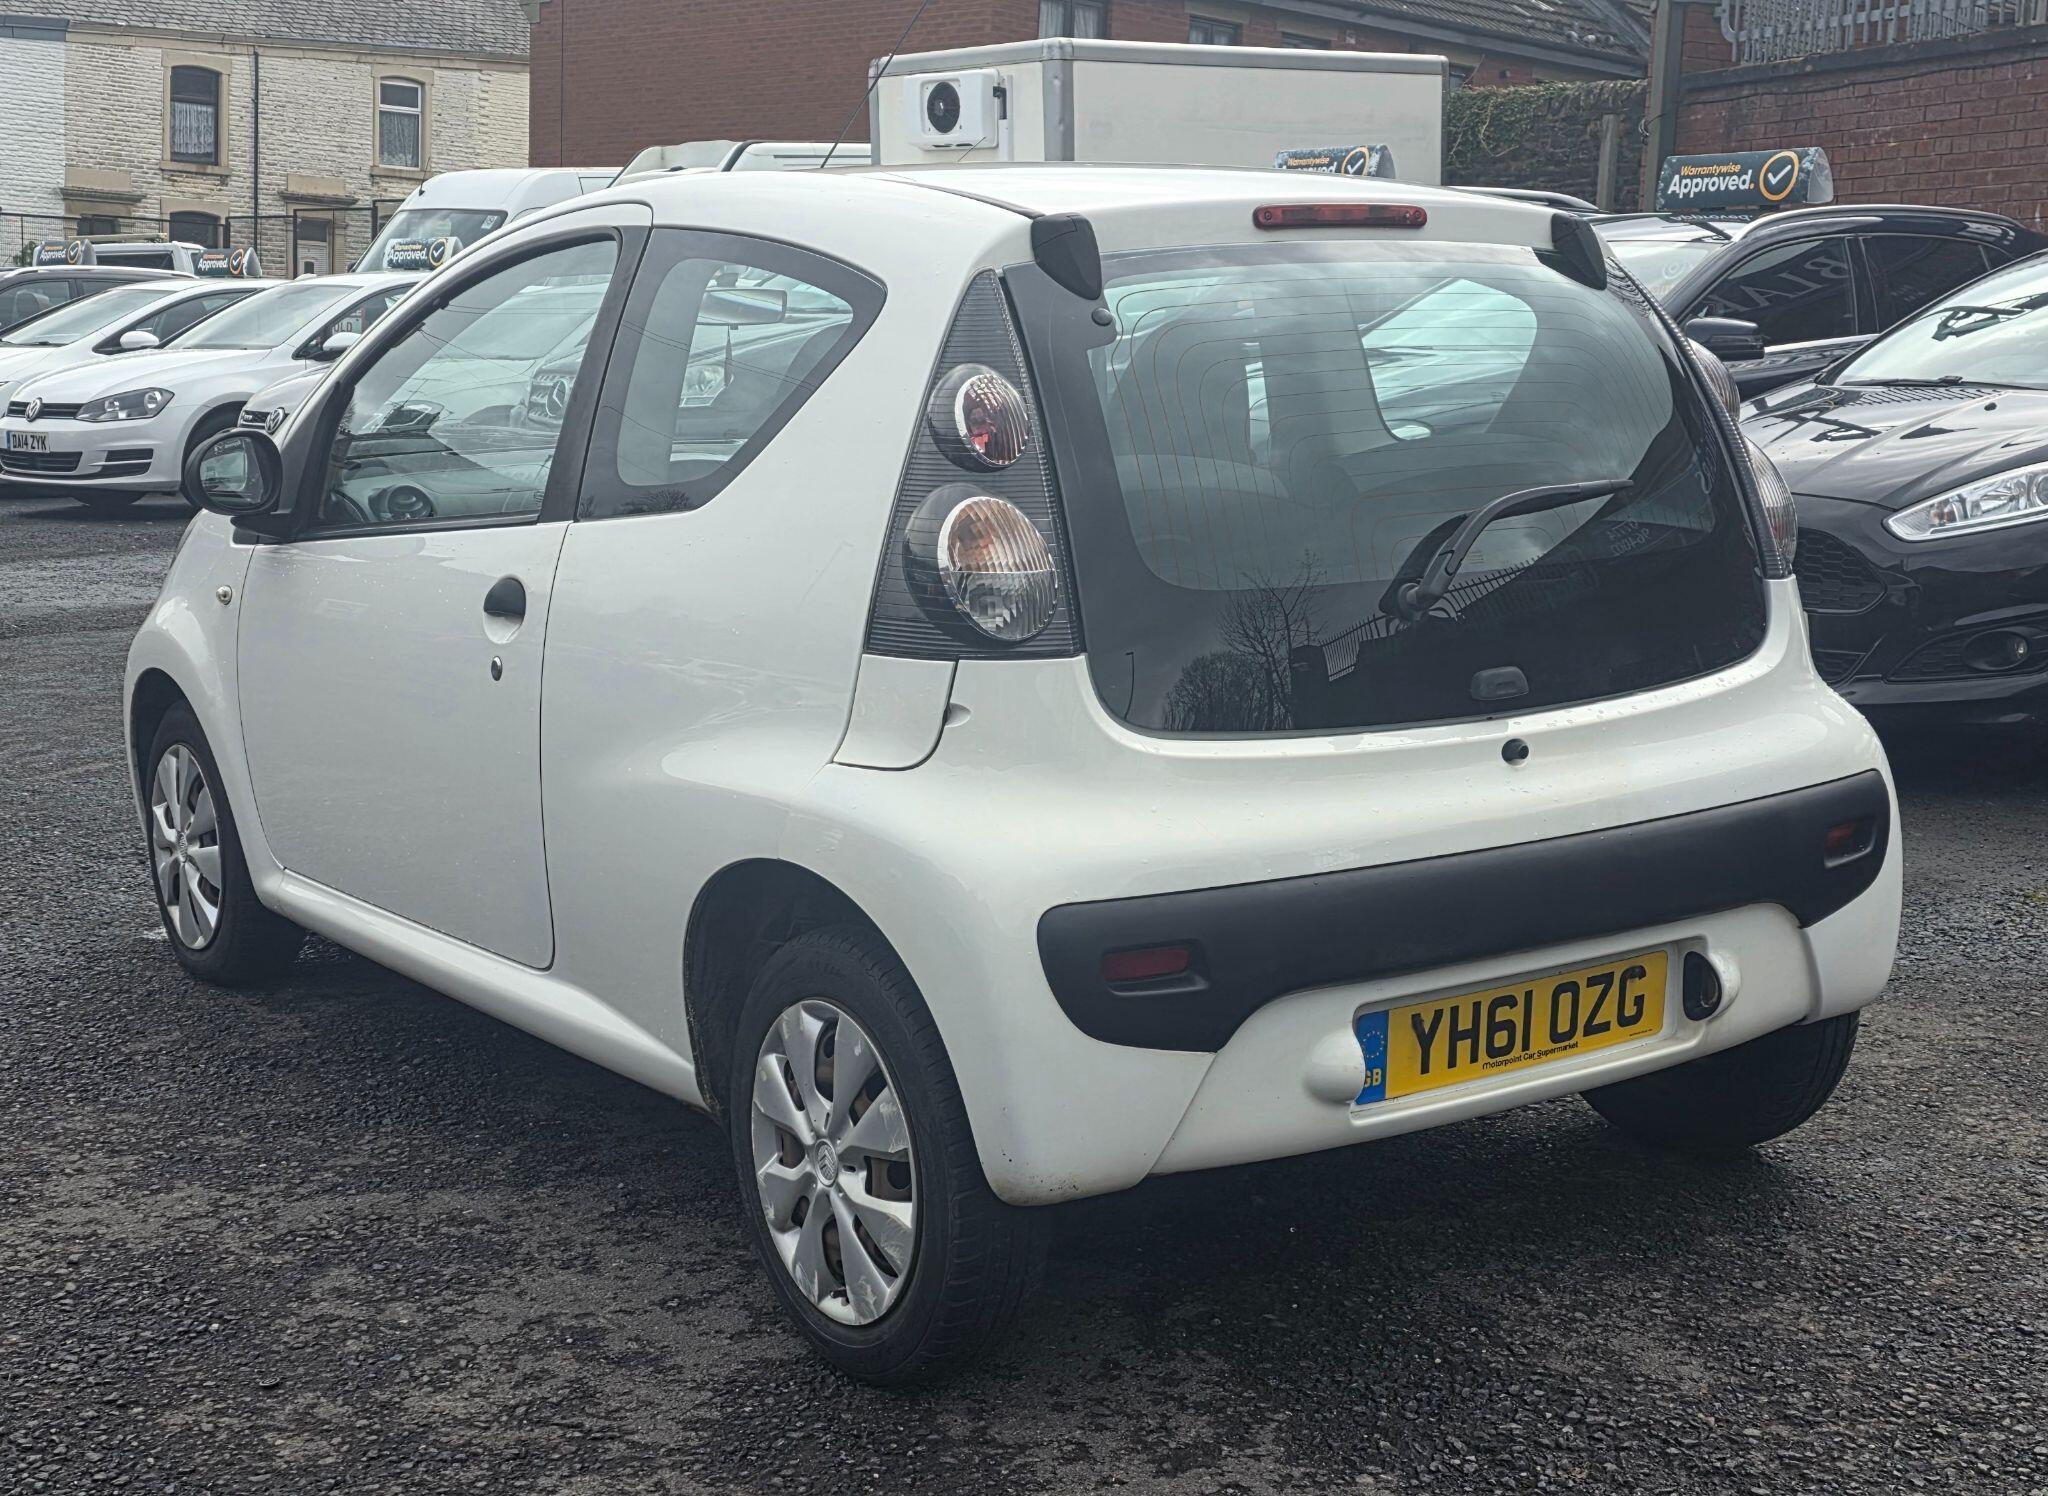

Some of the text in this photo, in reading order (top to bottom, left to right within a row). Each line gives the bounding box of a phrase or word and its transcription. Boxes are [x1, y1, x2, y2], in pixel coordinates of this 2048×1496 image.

[1680, 162, 1741, 176] Warrantywise
[1667, 169, 1755, 198] Approved.
[12, 434, 47, 450] DA14 ZYK
[1411, 965, 1647, 1074] YH61 OZG
[1524, 1052, 1536, 1060] Car
[1537, 1041, 1579, 1057] Supermarket
